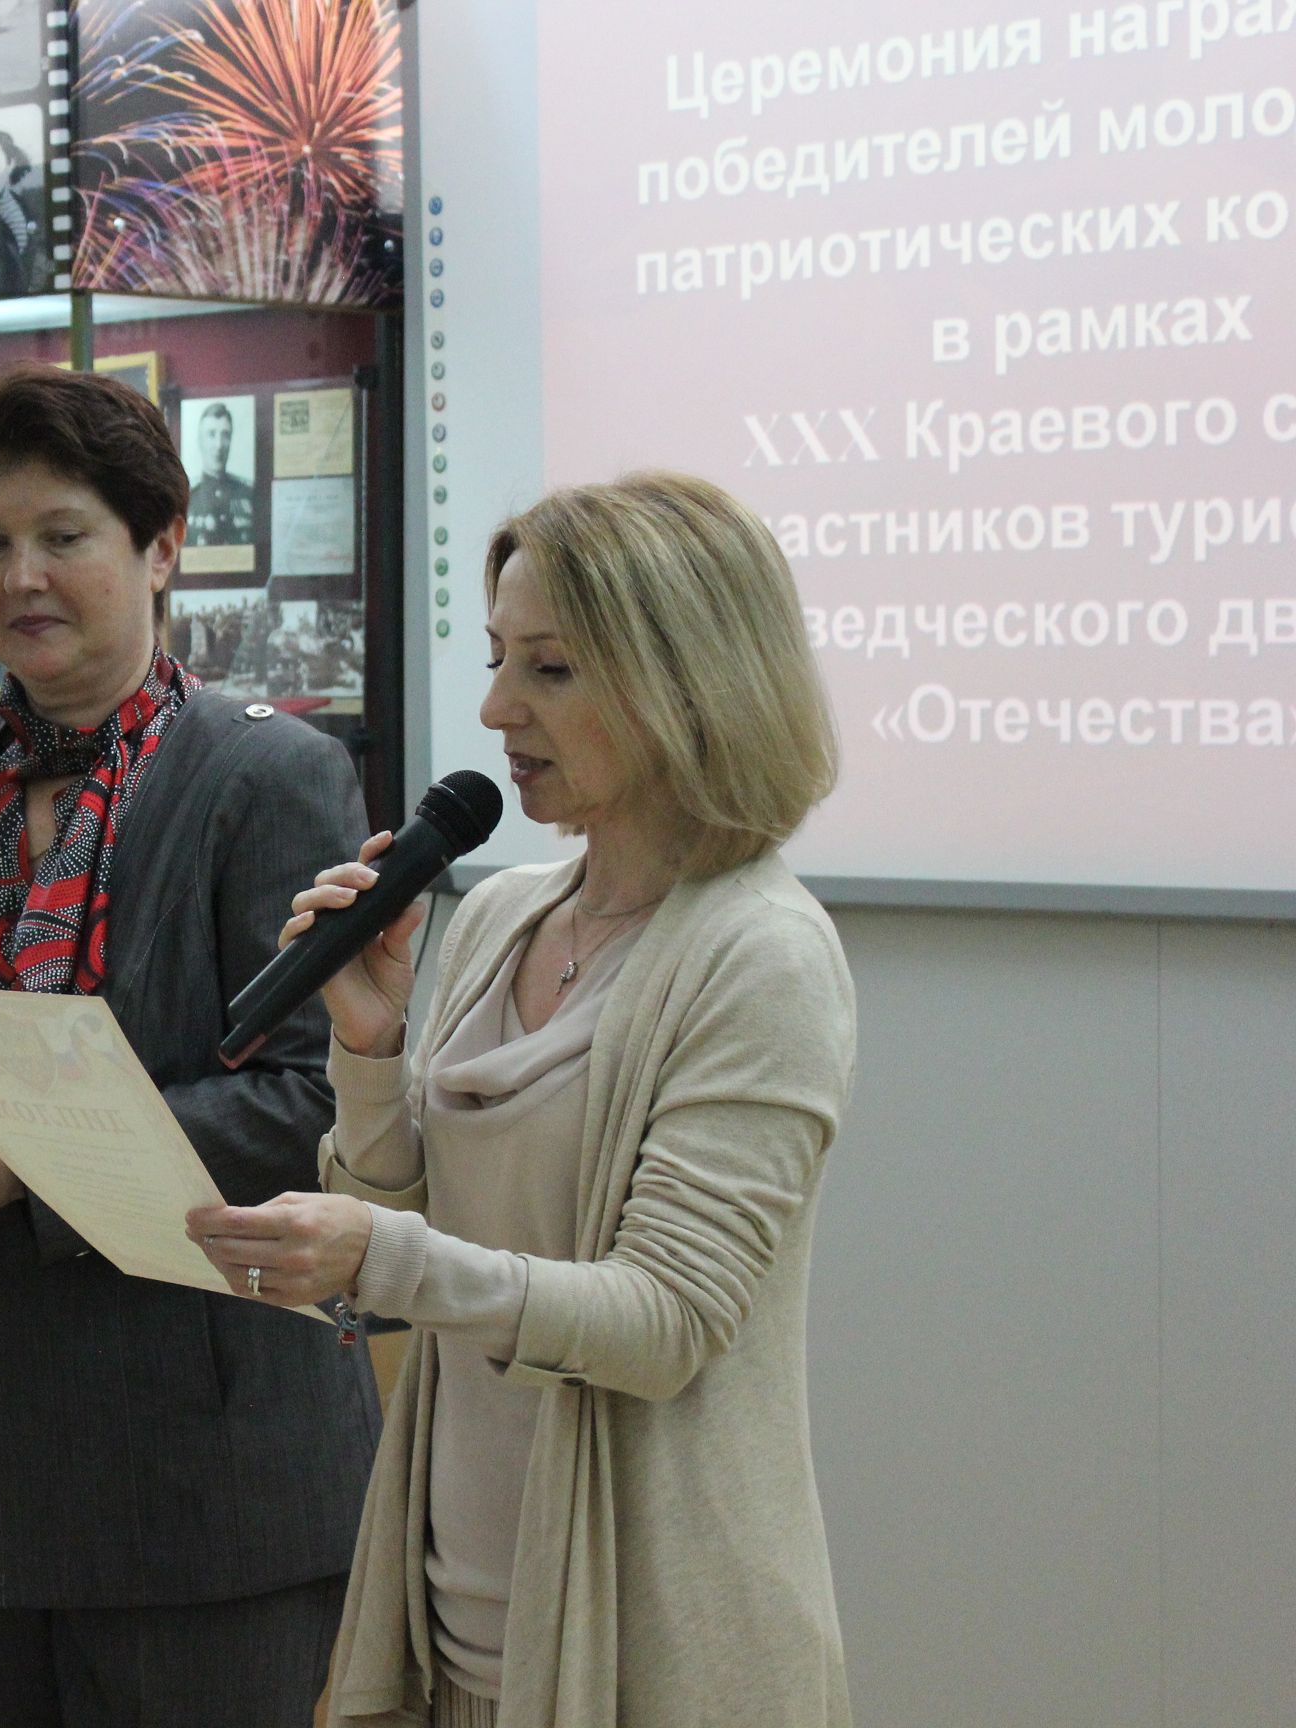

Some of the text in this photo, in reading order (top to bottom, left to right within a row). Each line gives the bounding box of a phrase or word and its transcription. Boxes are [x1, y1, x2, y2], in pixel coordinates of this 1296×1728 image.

[666, 16, 1043, 119] Церемония
[638, 86, 1296, 205] победителей моло
[636, 190, 1289, 300] патриотических ко
[931, 294, 1254, 376] в рамках
[905, 397, 1238, 473] Краевого
[1110, 494, 1296, 565] тури
